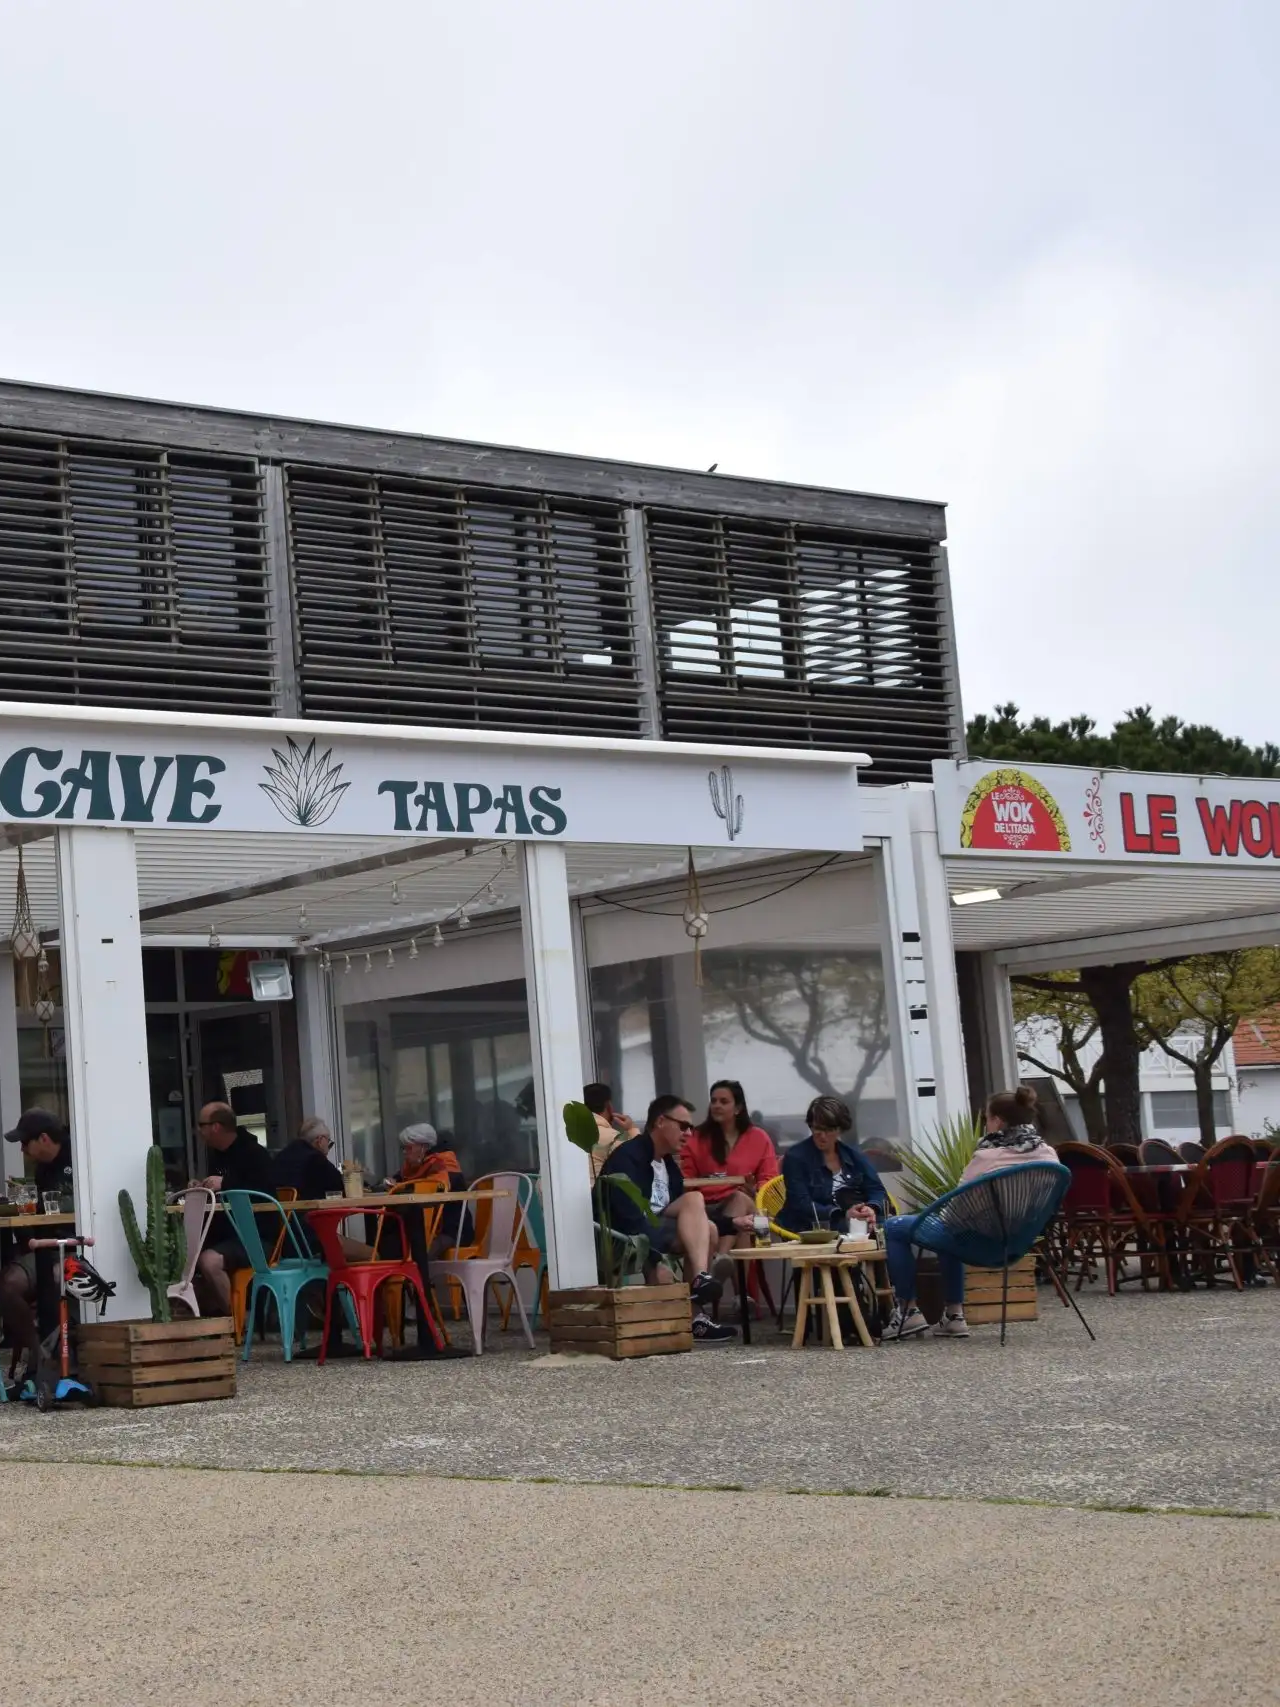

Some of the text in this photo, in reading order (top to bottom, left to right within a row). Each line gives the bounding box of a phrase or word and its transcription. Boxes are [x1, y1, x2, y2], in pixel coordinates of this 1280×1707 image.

[377, 780, 567, 836] TAPAS
[992, 800, 1034, 823] WOK
[1119, 792, 1181, 855] LE
